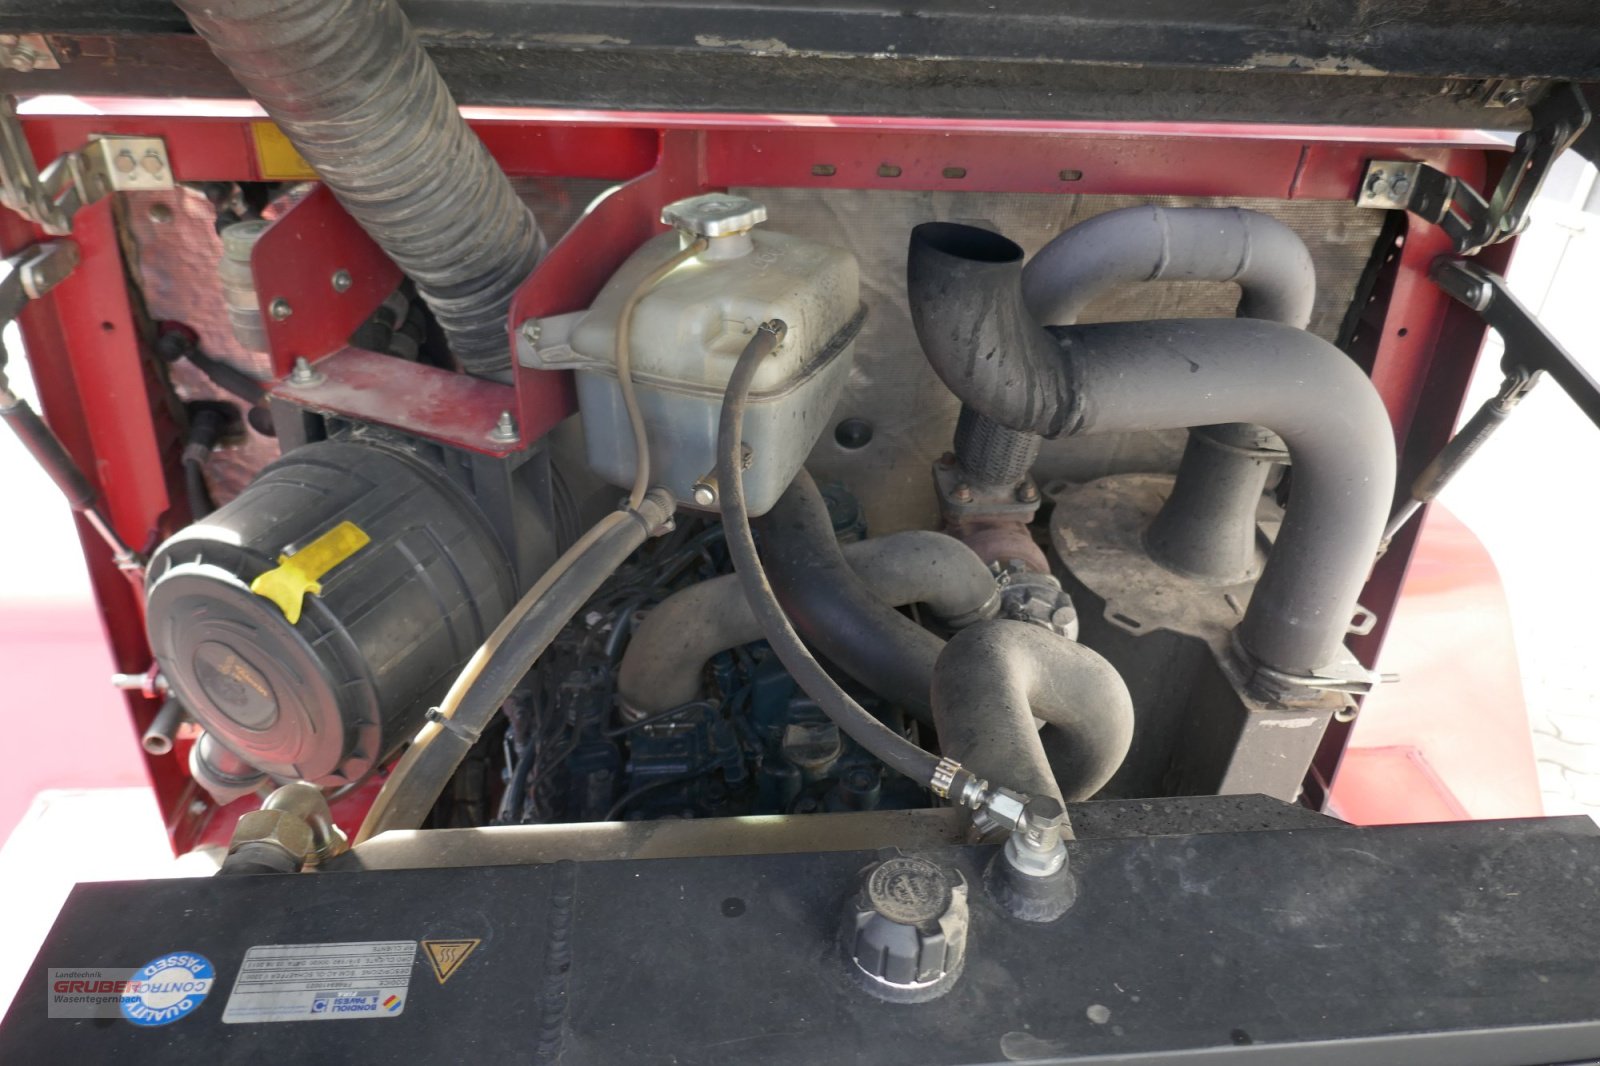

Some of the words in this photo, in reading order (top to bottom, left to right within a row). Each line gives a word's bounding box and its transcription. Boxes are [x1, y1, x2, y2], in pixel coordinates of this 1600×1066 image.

[144, 955, 206, 977] PASSED
[127, 998, 193, 1022] QUALITY
[332, 1004, 377, 1012] BONDIOLI
